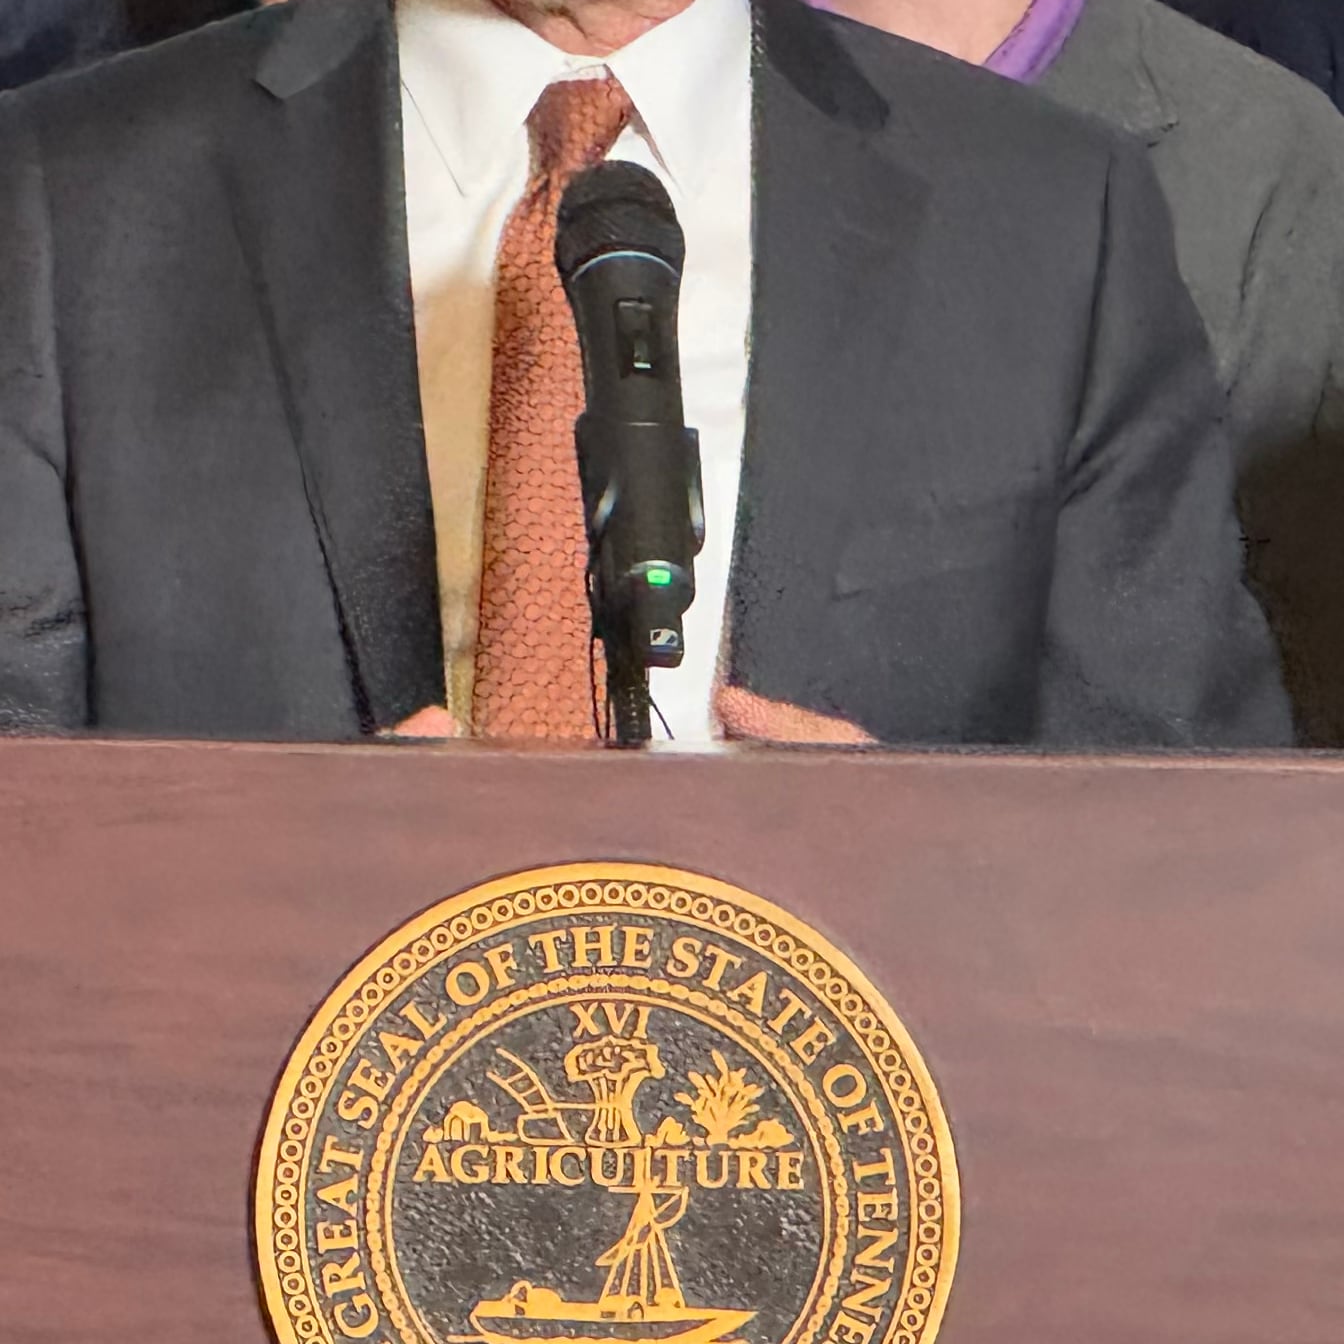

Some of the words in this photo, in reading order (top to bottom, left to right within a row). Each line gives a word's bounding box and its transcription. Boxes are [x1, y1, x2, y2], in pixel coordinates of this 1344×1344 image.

[444, 943, 518, 1007] OF
[528, 924, 655, 974] THE
[569, 1002, 652, 1040] XVI
[666, 936, 836, 1066] STATE
[337, 1003, 448, 1130] SEAL
[822, 1063, 885, 1136] OF
[413, 1145, 805, 1192] AGRICULTURE
[316, 1134, 380, 1339] GREAT
